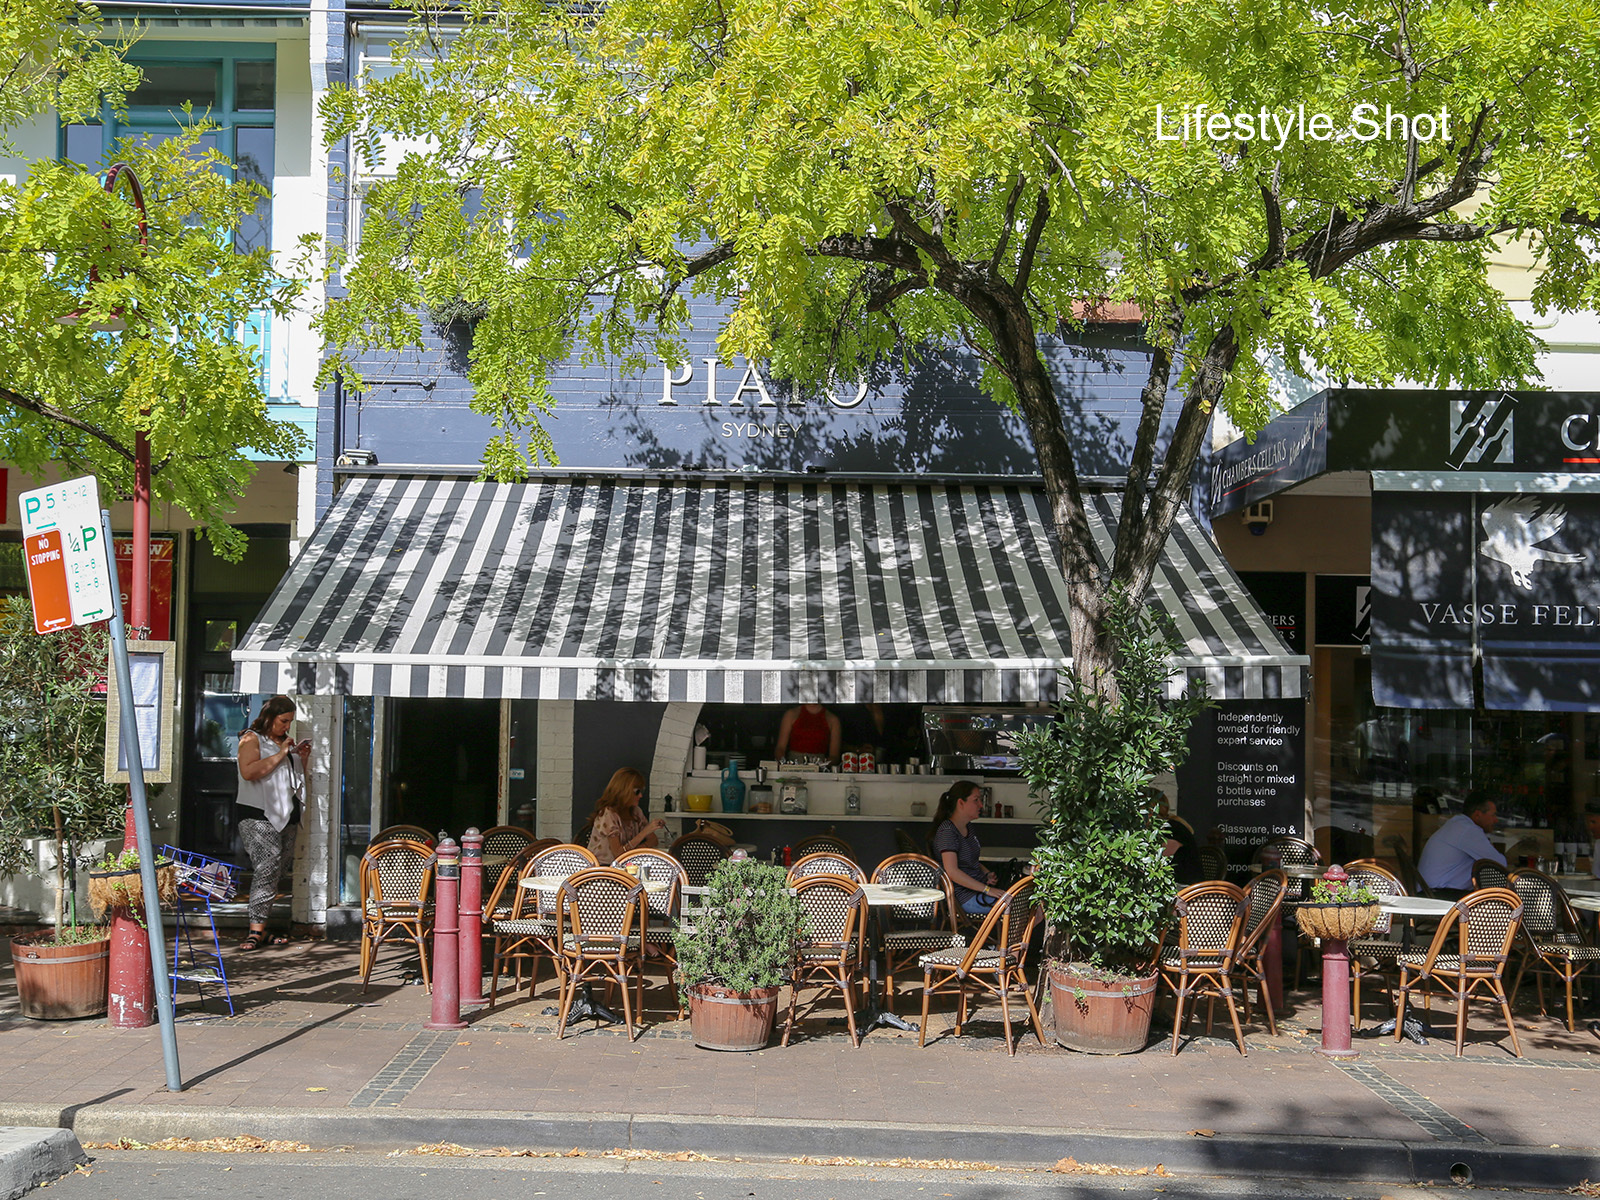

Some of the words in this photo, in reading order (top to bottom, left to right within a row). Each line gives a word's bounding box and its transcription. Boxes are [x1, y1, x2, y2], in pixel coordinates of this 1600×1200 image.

[657, 357, 868, 409] PIAO
[721, 422, 802, 438] SYDNEY
[1561, 414, 1600, 450] C
[1222, 454, 1257, 489] CHAMBERS
[1257, 438, 1287, 473] CELLARS
[25, 497, 41, 524] P
[46, 493, 56, 509] 5
[38, 538, 49, 550] NO
[30, 549, 61, 566] STOPPING
[1419, 603, 1518, 625] VASSE
[1532, 604, 1600, 626] FEL
[1217, 712, 1284, 725] Independently
[1217, 724, 1249, 734] owned
[1251, 724, 1264, 734] for
[1266, 724, 1300, 736] friendly
[1217, 736, 1247, 746] expert
[1249, 736, 1283, 746] service
[1217, 761, 1264, 771] Discounts
[1265, 764, 1278, 772] on
[1217, 774, 1252, 784] straight
[1254, 775, 1264, 783] or
[1266, 774, 1295, 784] mixed
[1217, 785, 1223, 795] 6
[1225, 786, 1252, 795] bottle
[1254, 786, 1276, 796] wine
[1217, 798, 1266, 807] purchases
[1217, 824, 1270, 834] Glassware,
[1272, 825, 1286, 834] ice
[1288, 825, 1296, 834] &
